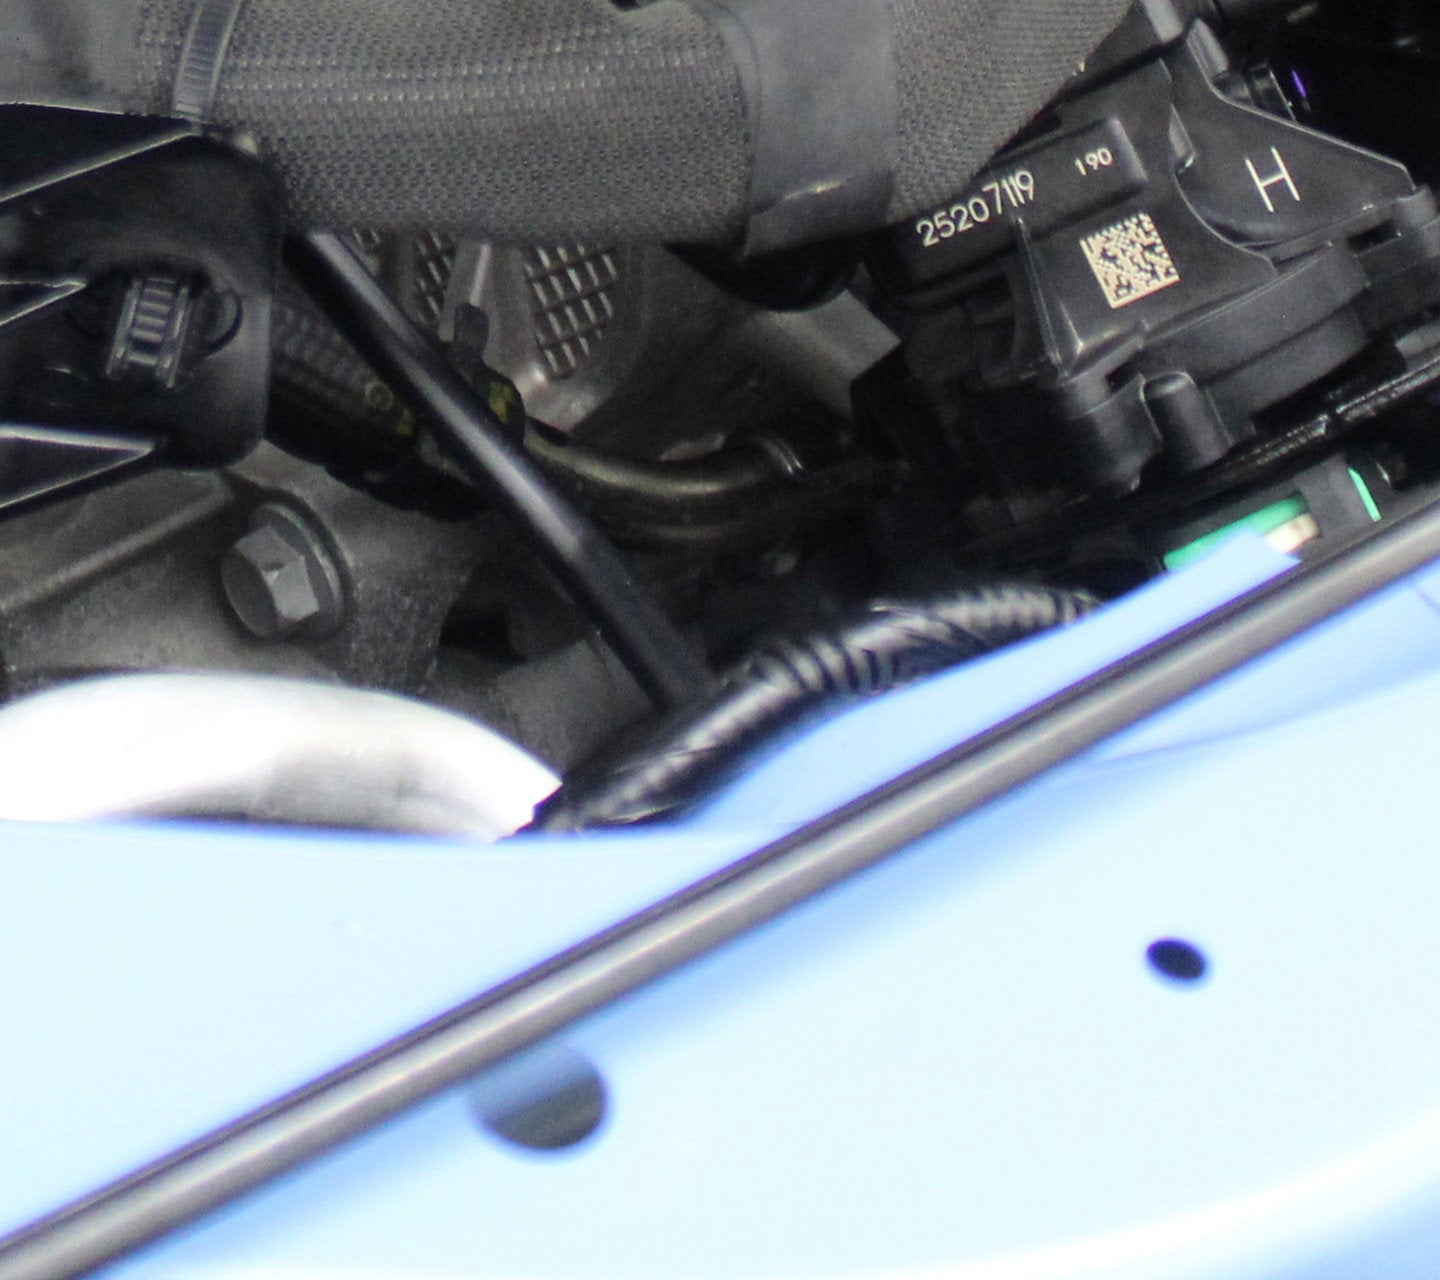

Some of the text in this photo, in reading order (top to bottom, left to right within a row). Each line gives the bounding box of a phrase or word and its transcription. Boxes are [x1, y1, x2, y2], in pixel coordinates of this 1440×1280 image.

[915, 147, 1113, 248] 25207119 190
[1244, 145, 1301, 213] H
